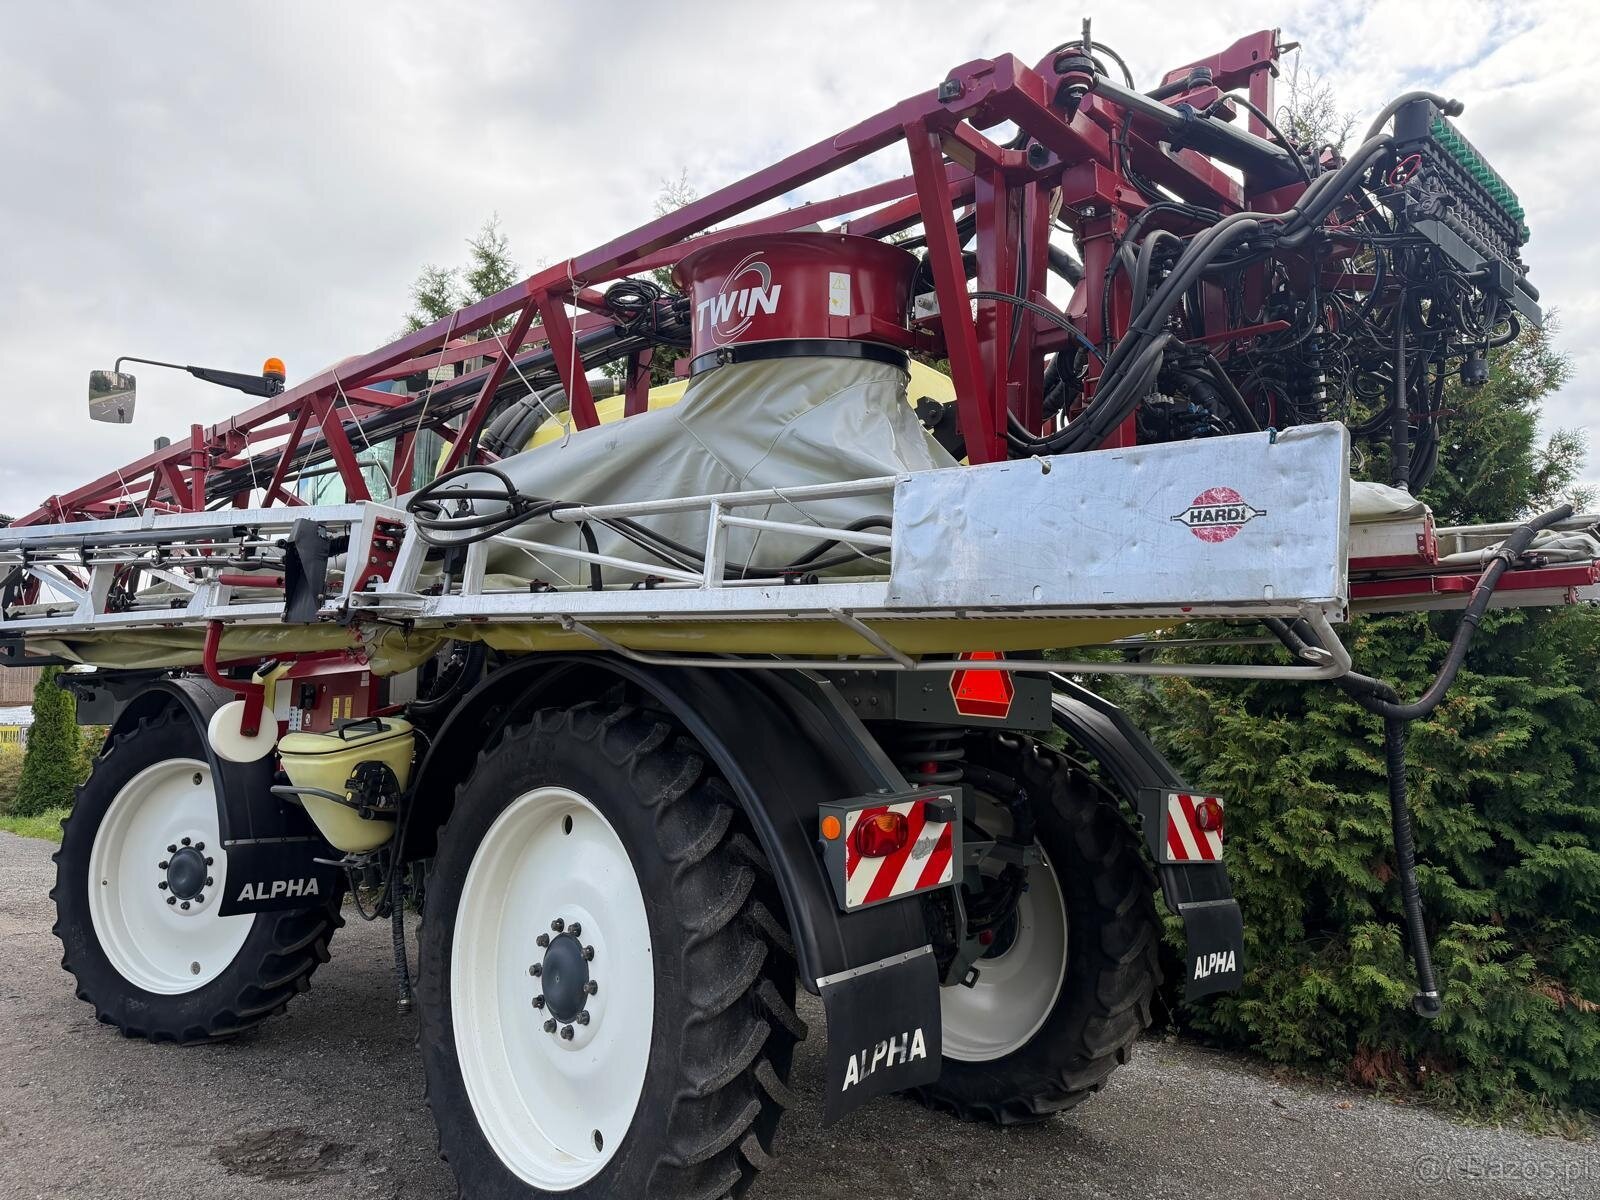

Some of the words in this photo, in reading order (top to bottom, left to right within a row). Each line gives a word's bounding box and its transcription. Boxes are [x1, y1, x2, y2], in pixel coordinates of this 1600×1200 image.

[697, 284, 782, 332] TWIN
[237, 877, 319, 902] ALPHA
[1193, 950, 1236, 980] ALPHA
[842, 1027, 927, 1092] ALPHA
